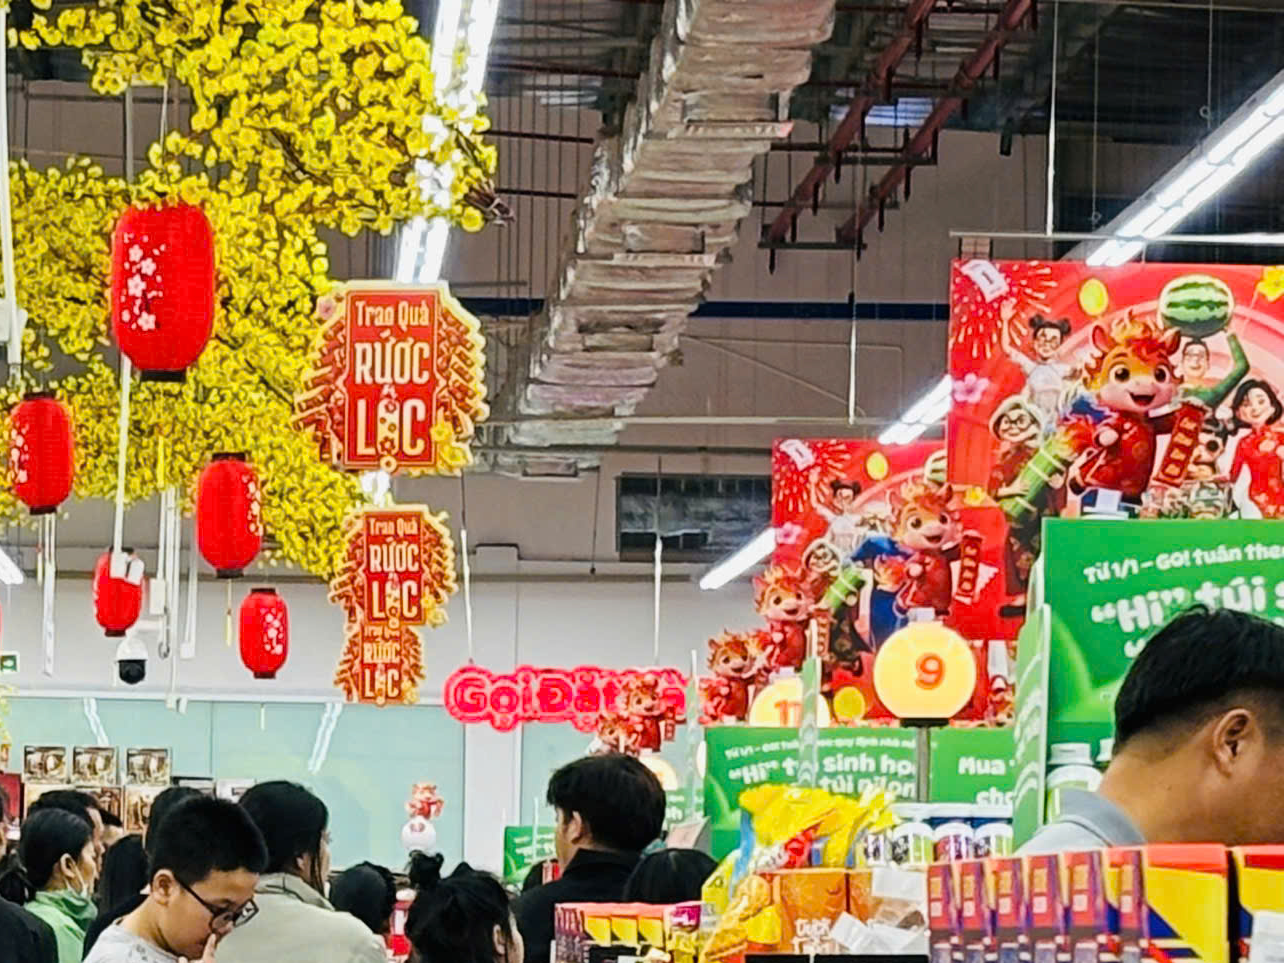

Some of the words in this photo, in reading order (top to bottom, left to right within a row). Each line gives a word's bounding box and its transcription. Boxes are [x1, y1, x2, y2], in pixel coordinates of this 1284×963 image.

[355, 300, 395, 327] Trao
[397, 299, 430, 332] Quà
[1155, 550, 1191, 571] GO!
[1244, 542, 1284, 561] the
[915, 654, 946, 688] 9
[822, 752, 875, 773] sinh
[958, 756, 1005, 776] Mua
